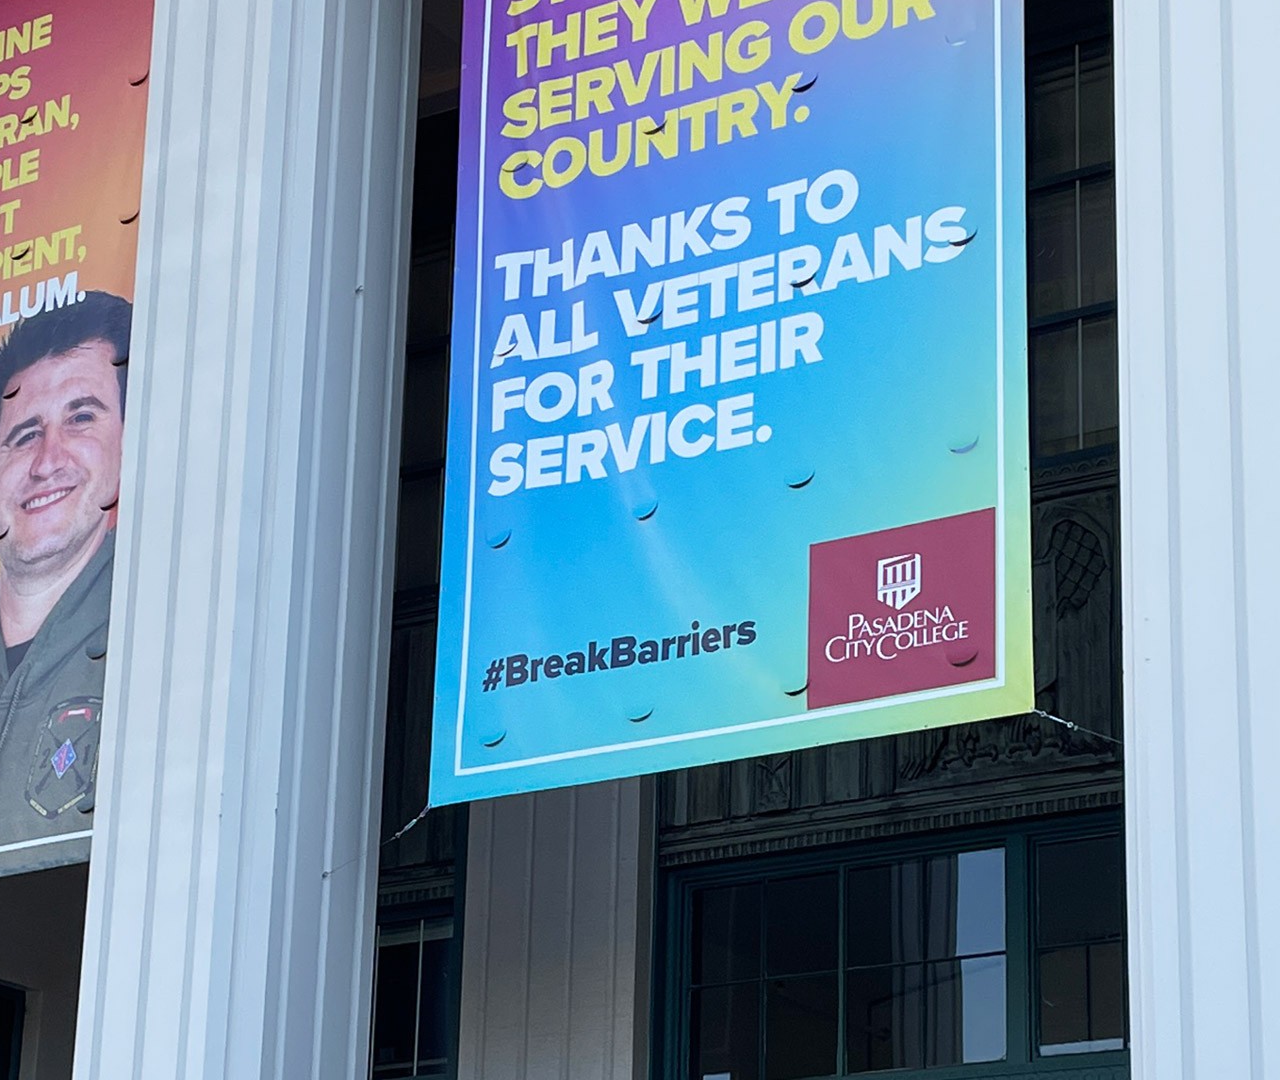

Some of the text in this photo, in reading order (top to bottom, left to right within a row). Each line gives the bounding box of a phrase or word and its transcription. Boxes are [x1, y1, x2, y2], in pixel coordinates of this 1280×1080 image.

[498, 71, 812, 200] COUNTRY.
[500, 19, 771, 139] SERVING
[490, 206, 969, 370] ALL VETERANS
[494, 168, 859, 302] THANKS TO
[490, 311, 824, 433] FOR THEIR
[487, 393, 773, 497] SERVICE.
[482, 619, 757, 693] #BreakBarriers
[847, 605, 955, 641] PASADENA
